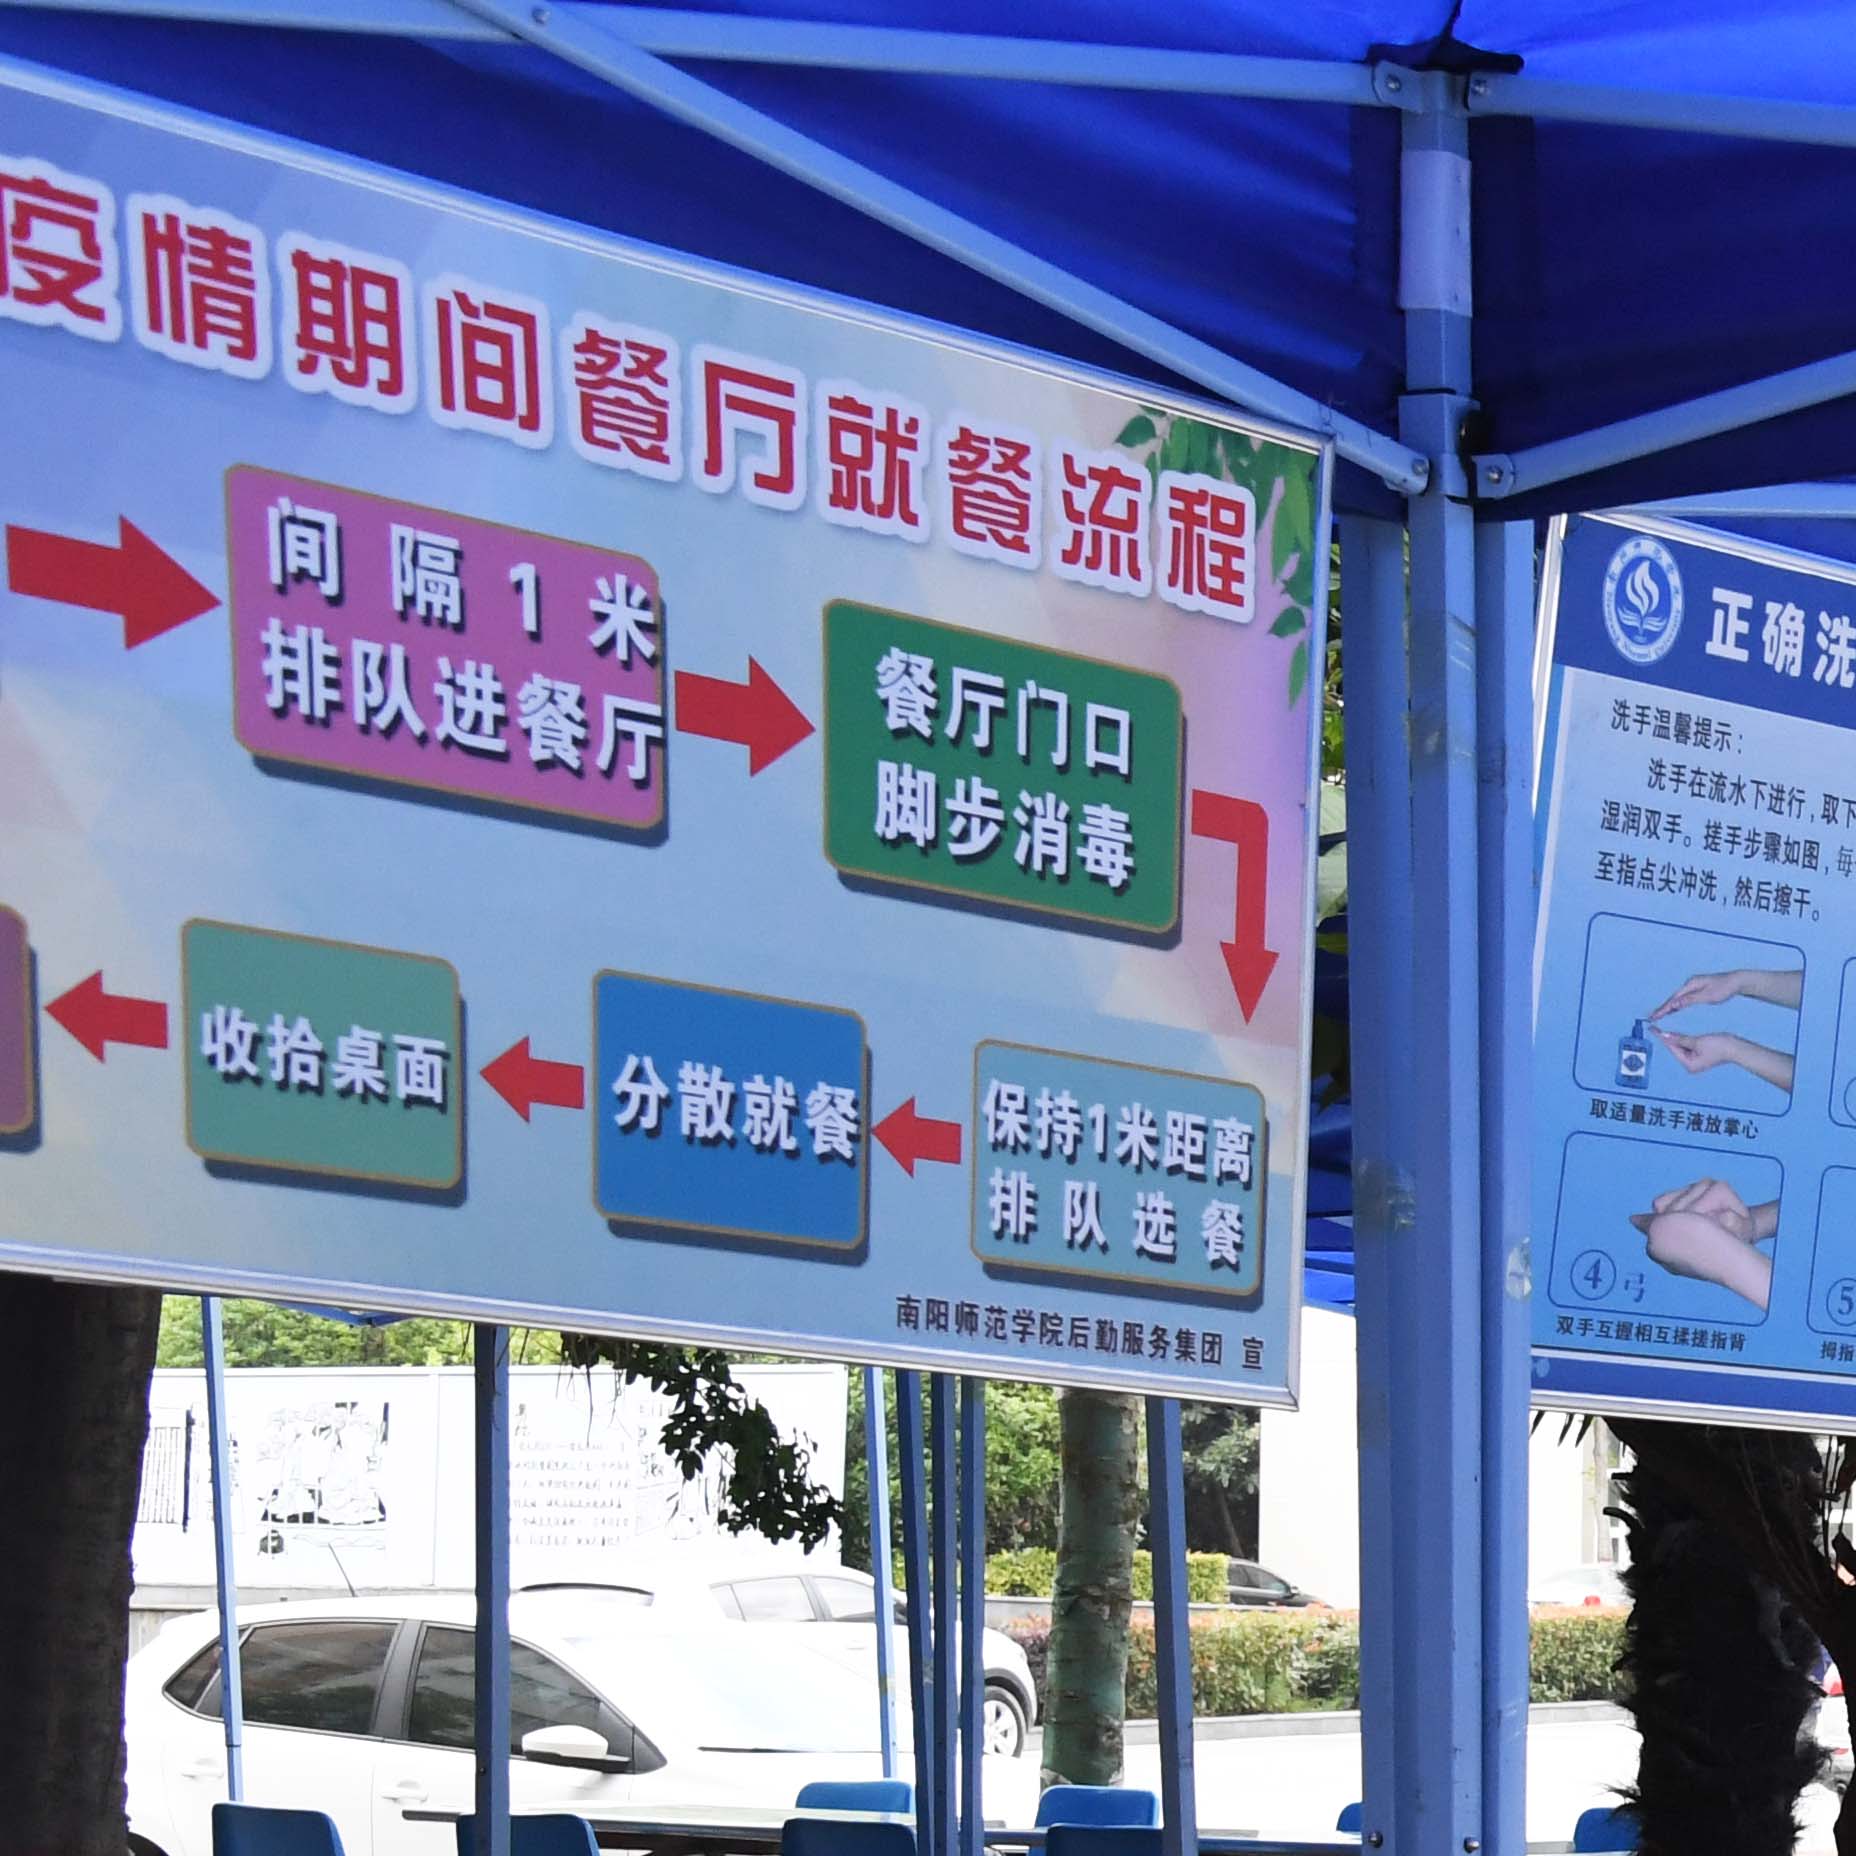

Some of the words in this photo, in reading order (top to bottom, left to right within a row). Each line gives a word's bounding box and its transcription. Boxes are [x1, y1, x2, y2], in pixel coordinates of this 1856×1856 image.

[0, 172, 1254, 612] 疫情期间餐厅就餐流程
[260, 625, 666, 786] 排队进餐厅
[874, 645, 1133, 782] 餐厅门口
[874, 758, 1136, 891] 脚步消毒
[200, 1006, 448, 1108] 收拾桌面
[611, 1053, 861, 1168] 分散就餐
[982, 1077, 1254, 1184] 保持1米距离
[1589, 1097, 1760, 1140] 取适量洗手液放掌心
[896, 1293, 1224, 1366] 南阳师范学院后勤服务集团
[1556, 1315, 1747, 1353] 双手互握相互揉搓指背
